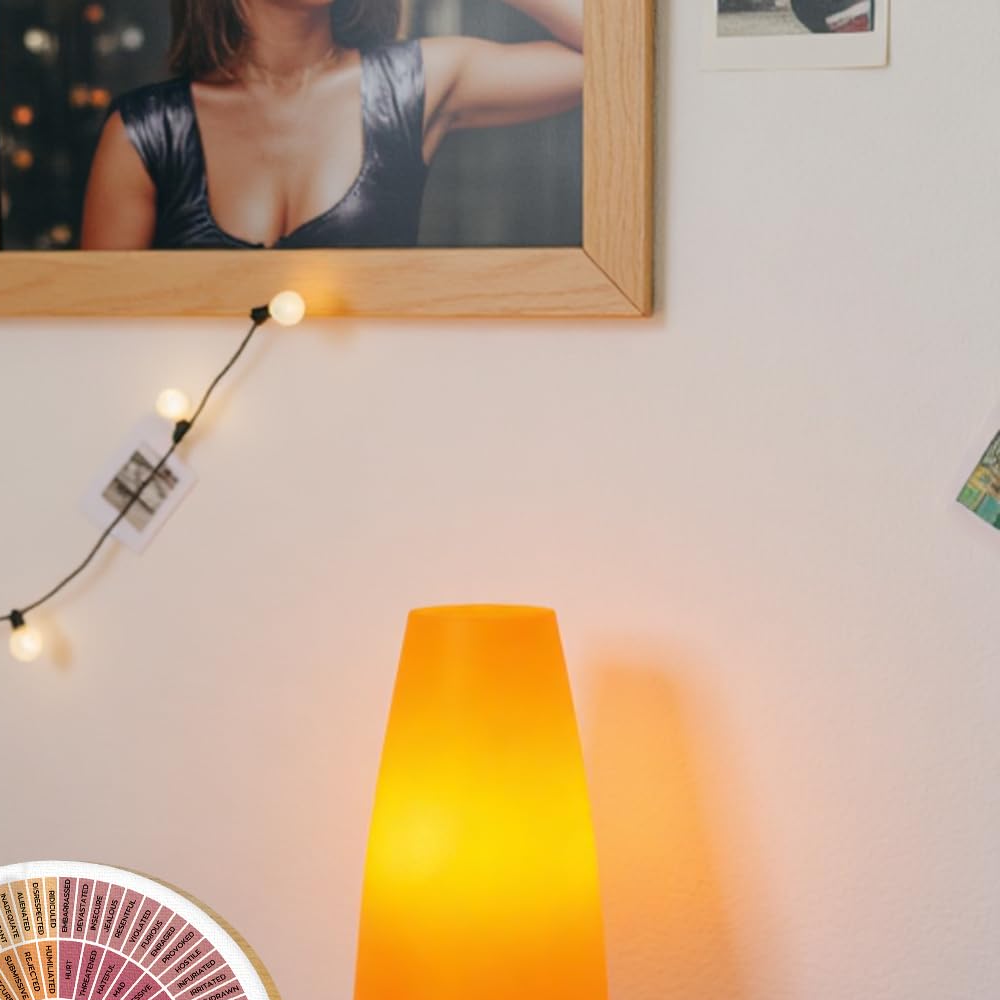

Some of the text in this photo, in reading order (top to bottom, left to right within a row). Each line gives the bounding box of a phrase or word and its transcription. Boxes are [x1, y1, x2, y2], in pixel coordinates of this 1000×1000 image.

[1, 893, 19, 939] INADEQUATE
[18, 892, 30, 931] ALIENATED
[33, 883, 44, 935] DISRESPECTED
[62, 879, 70, 933] EMBARRASSED
[77, 884, 89, 932] DEVASTATED
[90, 895, 103, 931] INSECURE
[104, 900, 118, 933] JEALOUS
[115, 899, 136, 938] RESENTFUL
[129, 910, 151, 943] VIOLATED
[141, 920, 163, 949] FURIOUS
[151, 926, 175, 957] ENRAGED
[162, 931, 195, 964] PROVOKED
[175, 949, 201, 973] HOSTILE
[5, 955, 29, 1000] SUBMISSIVE
[24, 951, 40, 992] REJECTED
[45, 945, 55, 994] HUMILIATED
[79, 950, 97, 997] THREATENED
[97, 964, 115, 994] HATEFUL
[177, 959, 216, 988] INFURIATED
[190, 974, 226, 996] IRRITATED
[113, 981, 126, 998] MAD
